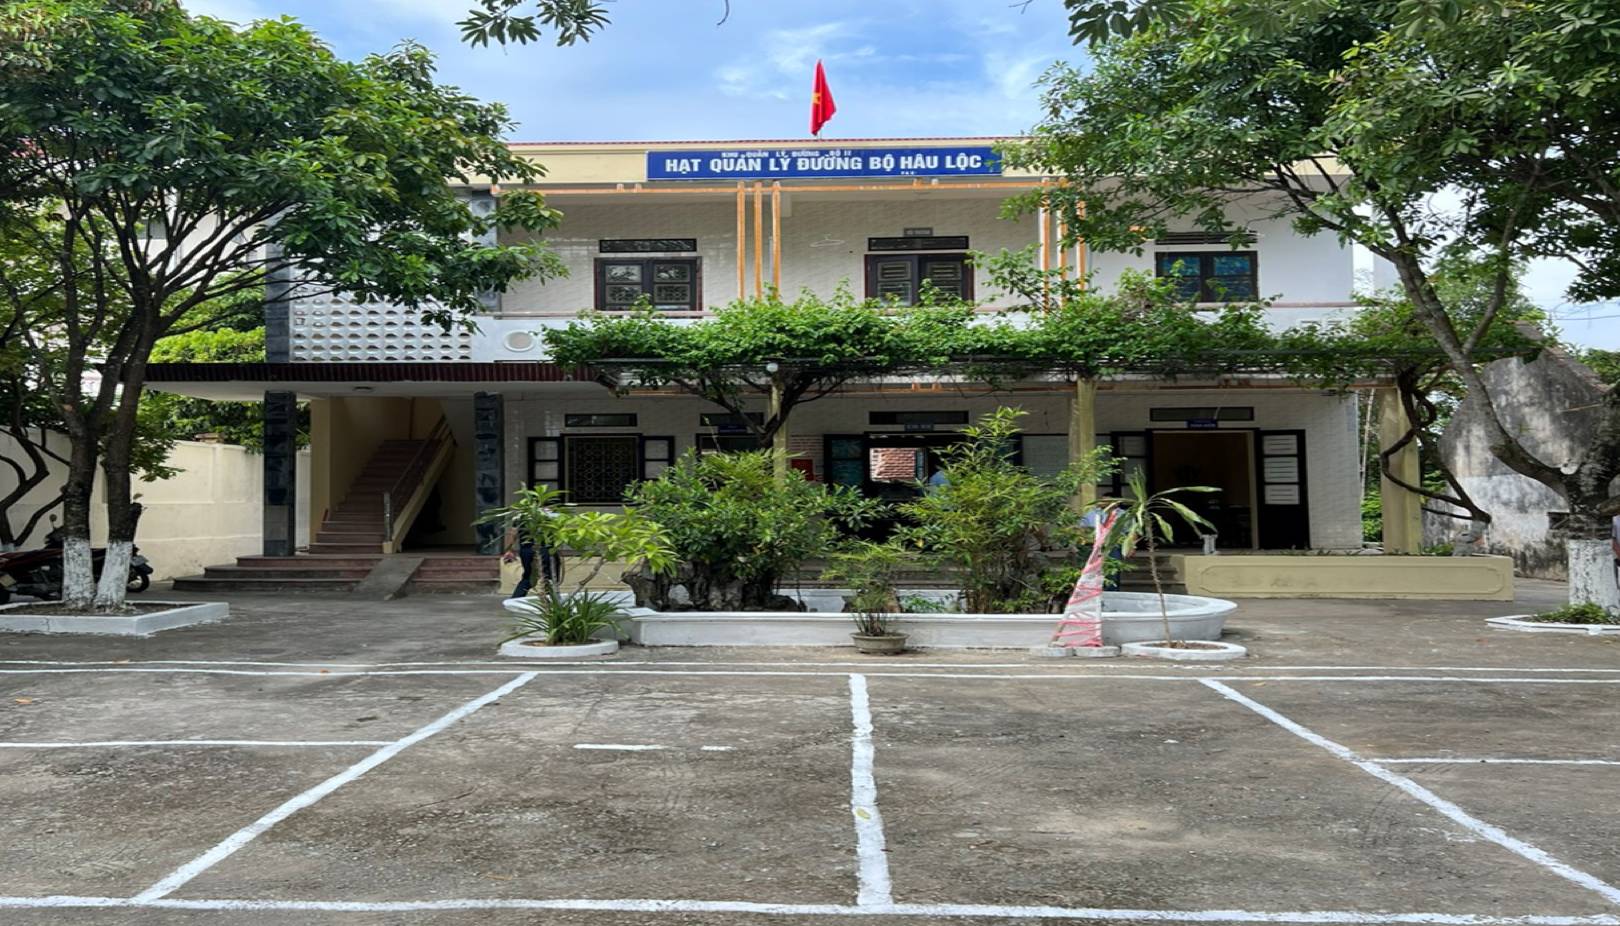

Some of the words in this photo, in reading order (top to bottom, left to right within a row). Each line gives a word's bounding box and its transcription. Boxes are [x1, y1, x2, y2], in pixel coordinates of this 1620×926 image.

[665, 159, 701, 174] HẠT
[710, 154, 761, 173] QUẢN
[769, 154, 791, 171] LÝ
[797, 154, 862, 171] ĐƯỜNG
[869, 153, 895, 172] BỘ
[945, 152, 981, 171] LỘC
